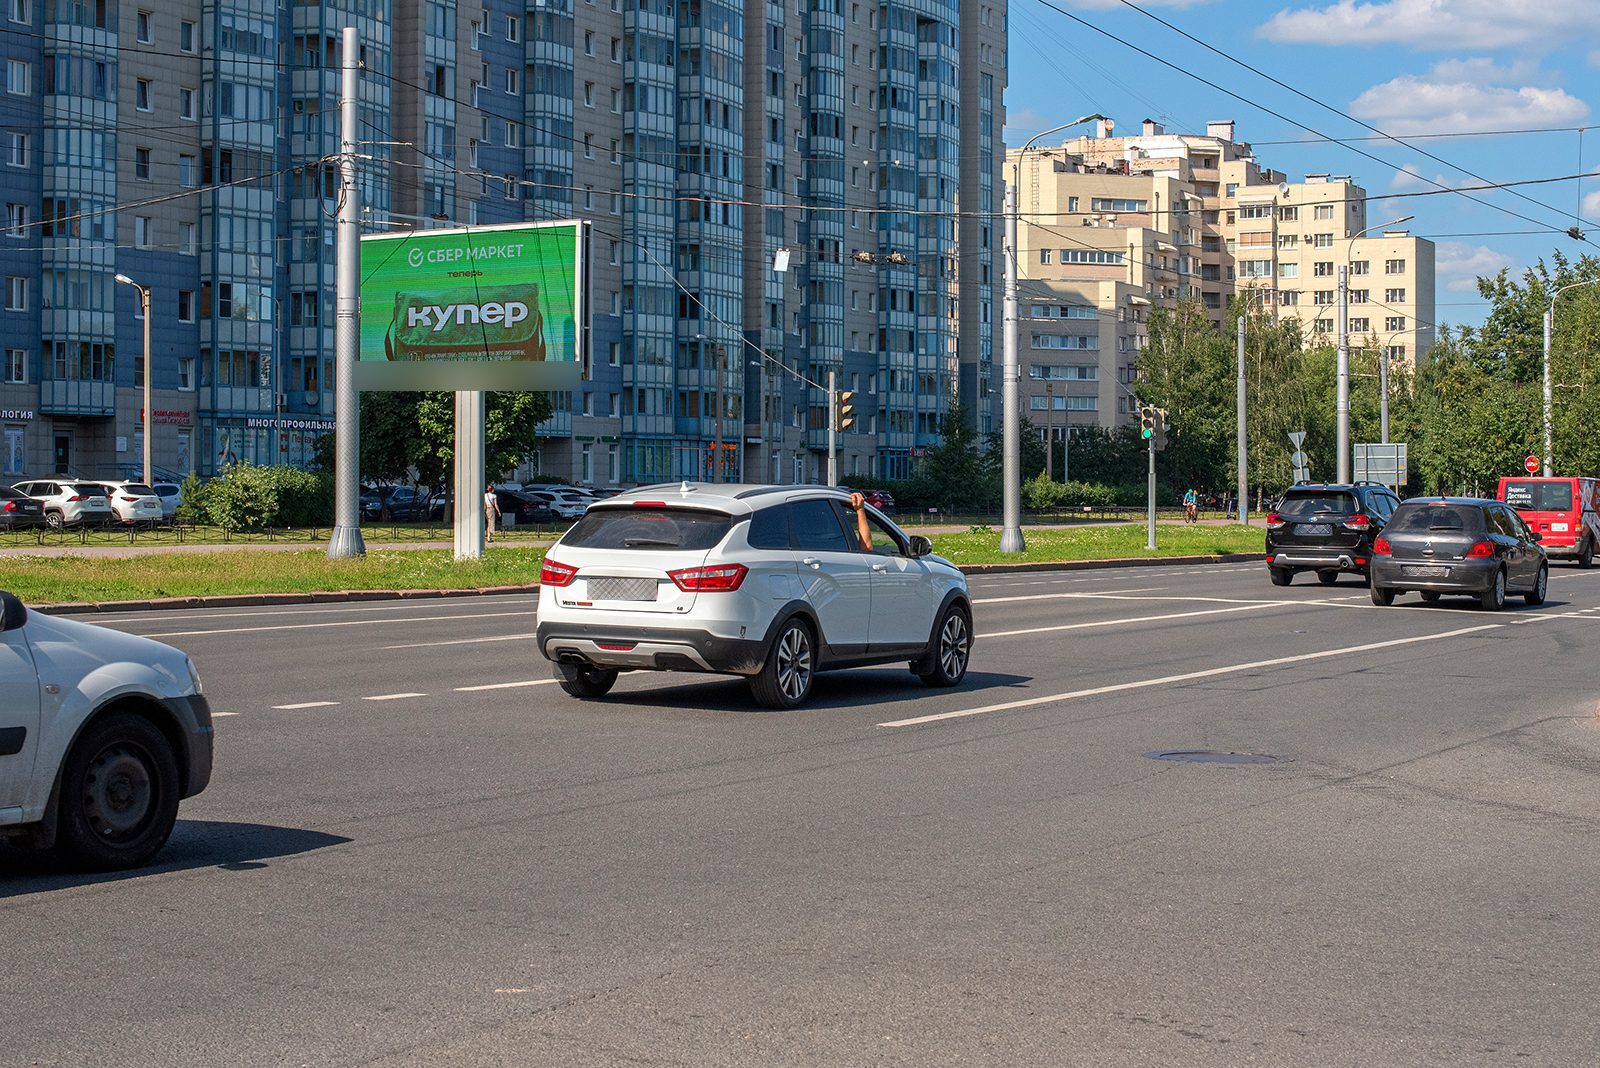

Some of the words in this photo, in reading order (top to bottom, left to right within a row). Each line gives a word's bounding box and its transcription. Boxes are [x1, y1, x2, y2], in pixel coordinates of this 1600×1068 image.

[427, 248, 463, 263] СБЕР
[466, 244, 524, 260] МАРКЕТ
[447, 269, 483, 278] теперь
[407, 301, 529, 332] купер
[0, 410, 33, 419] ЛОГИЯ
